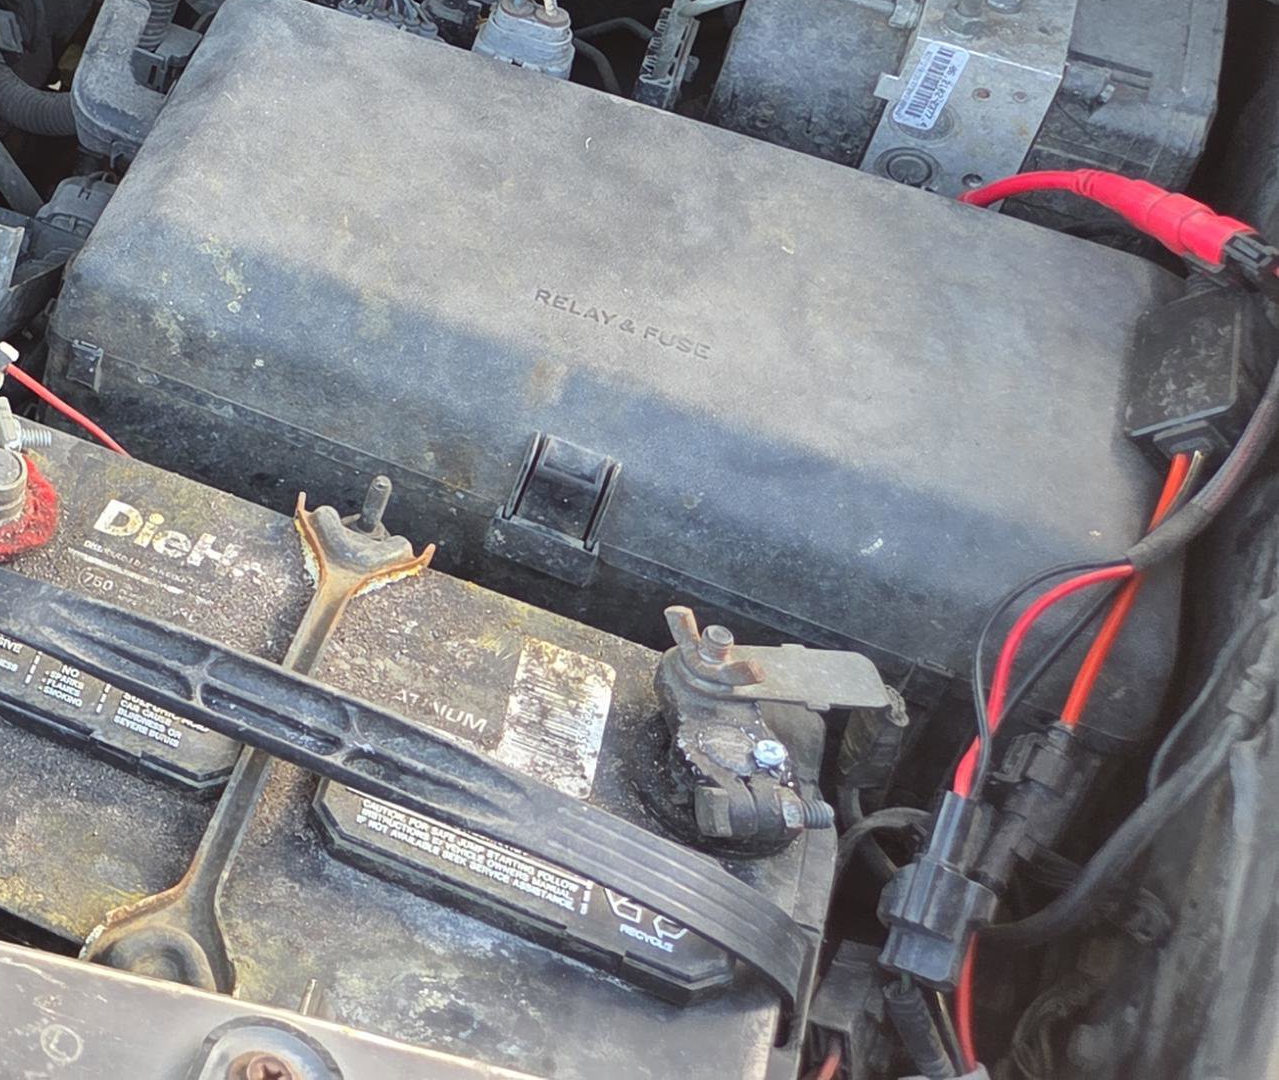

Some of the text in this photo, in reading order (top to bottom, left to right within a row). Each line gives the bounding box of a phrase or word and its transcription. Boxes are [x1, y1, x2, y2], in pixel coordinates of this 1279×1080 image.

[534, 287, 713, 361] RELAY & FUSE
[61, 664, 80, 678] NO
[116, 708, 183, 739] BLINDNESS OR
[119, 699, 173, 727] CAN CAUSE
[113, 717, 181, 748] SEVERE BURNS
[356, 815, 367, 824] IF
[368, 820, 389, 834] NOT
[389, 828, 441, 856] AVAILABLE
[441, 849, 467, 867] SEEK
[468, 861, 510, 884] SERVICE
[361, 807, 430, 841] INSTRUCTIONS
[443, 842, 485, 864] VEHICLE
[408, 818, 429, 832] FOR
[431, 827, 457, 843] SAFE
[457, 837, 485, 854] JUMP
[537, 870, 579, 892] FOLLOW
[618, 923, 676, 953] RECYCLE
